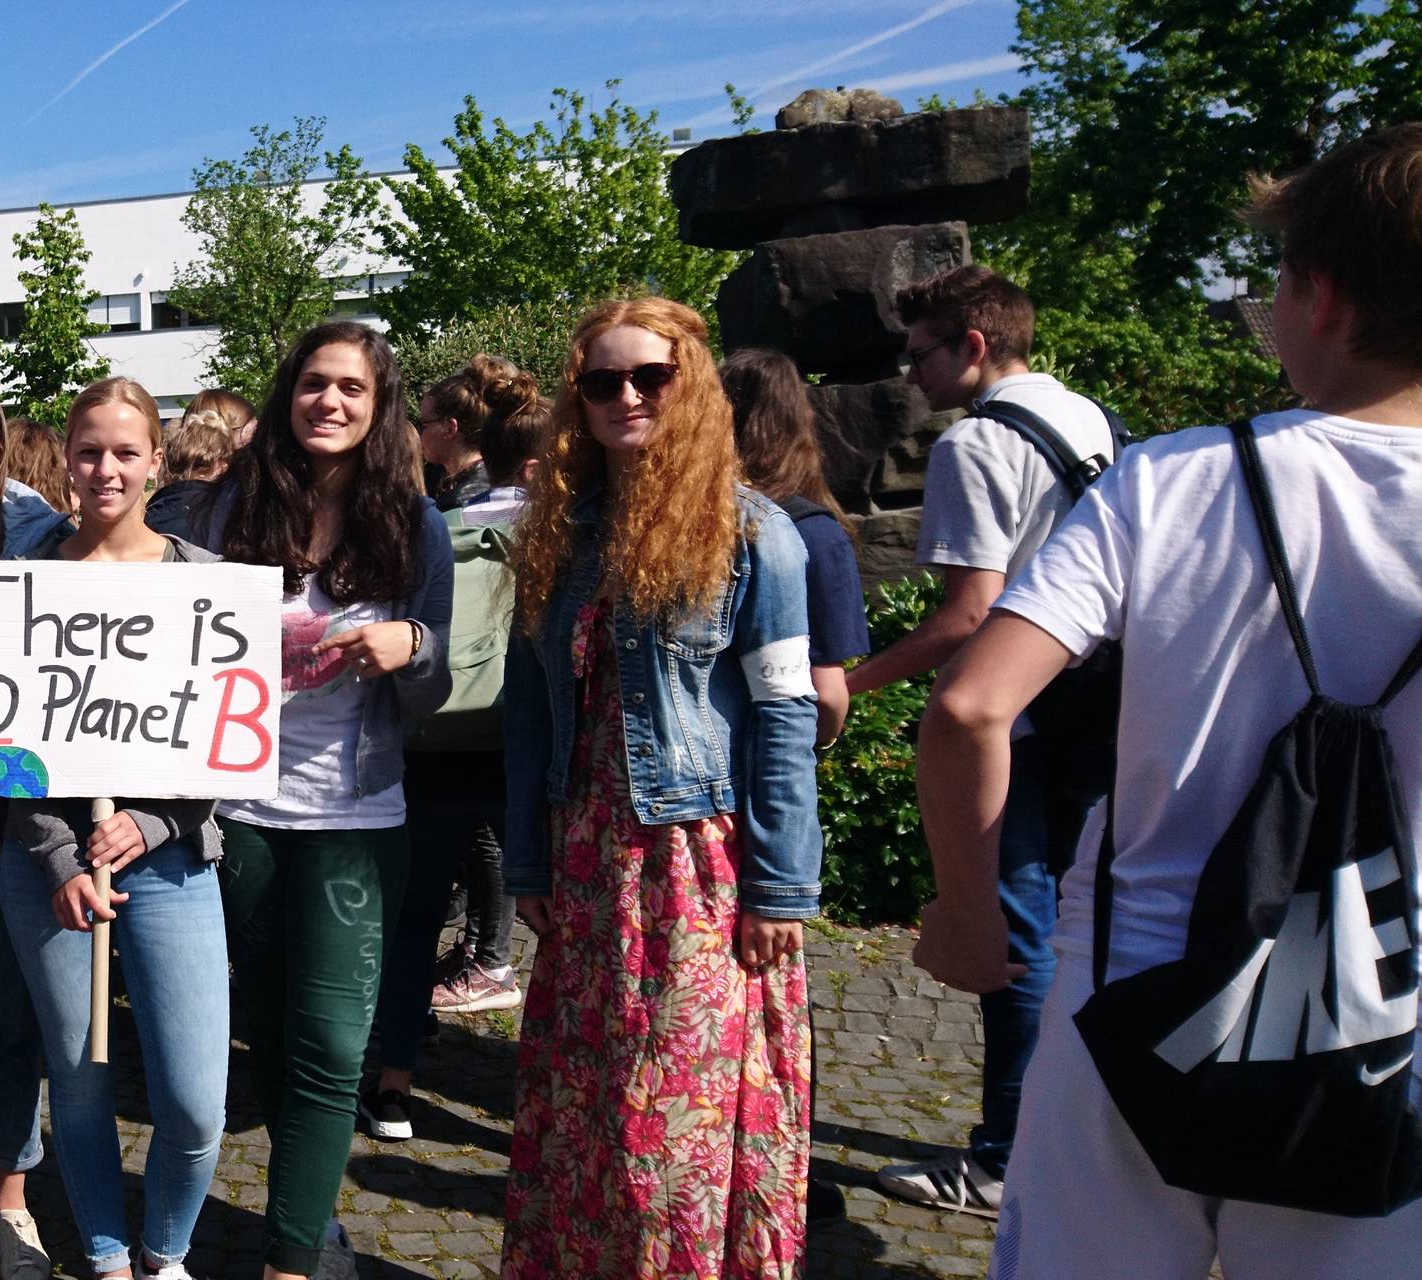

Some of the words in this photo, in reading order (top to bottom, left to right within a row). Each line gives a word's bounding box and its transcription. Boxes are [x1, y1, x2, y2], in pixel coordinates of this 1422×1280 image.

[191, 597, 249, 667] is
[38, 664, 200, 750] Planet
[207, 667, 272, 773] B
